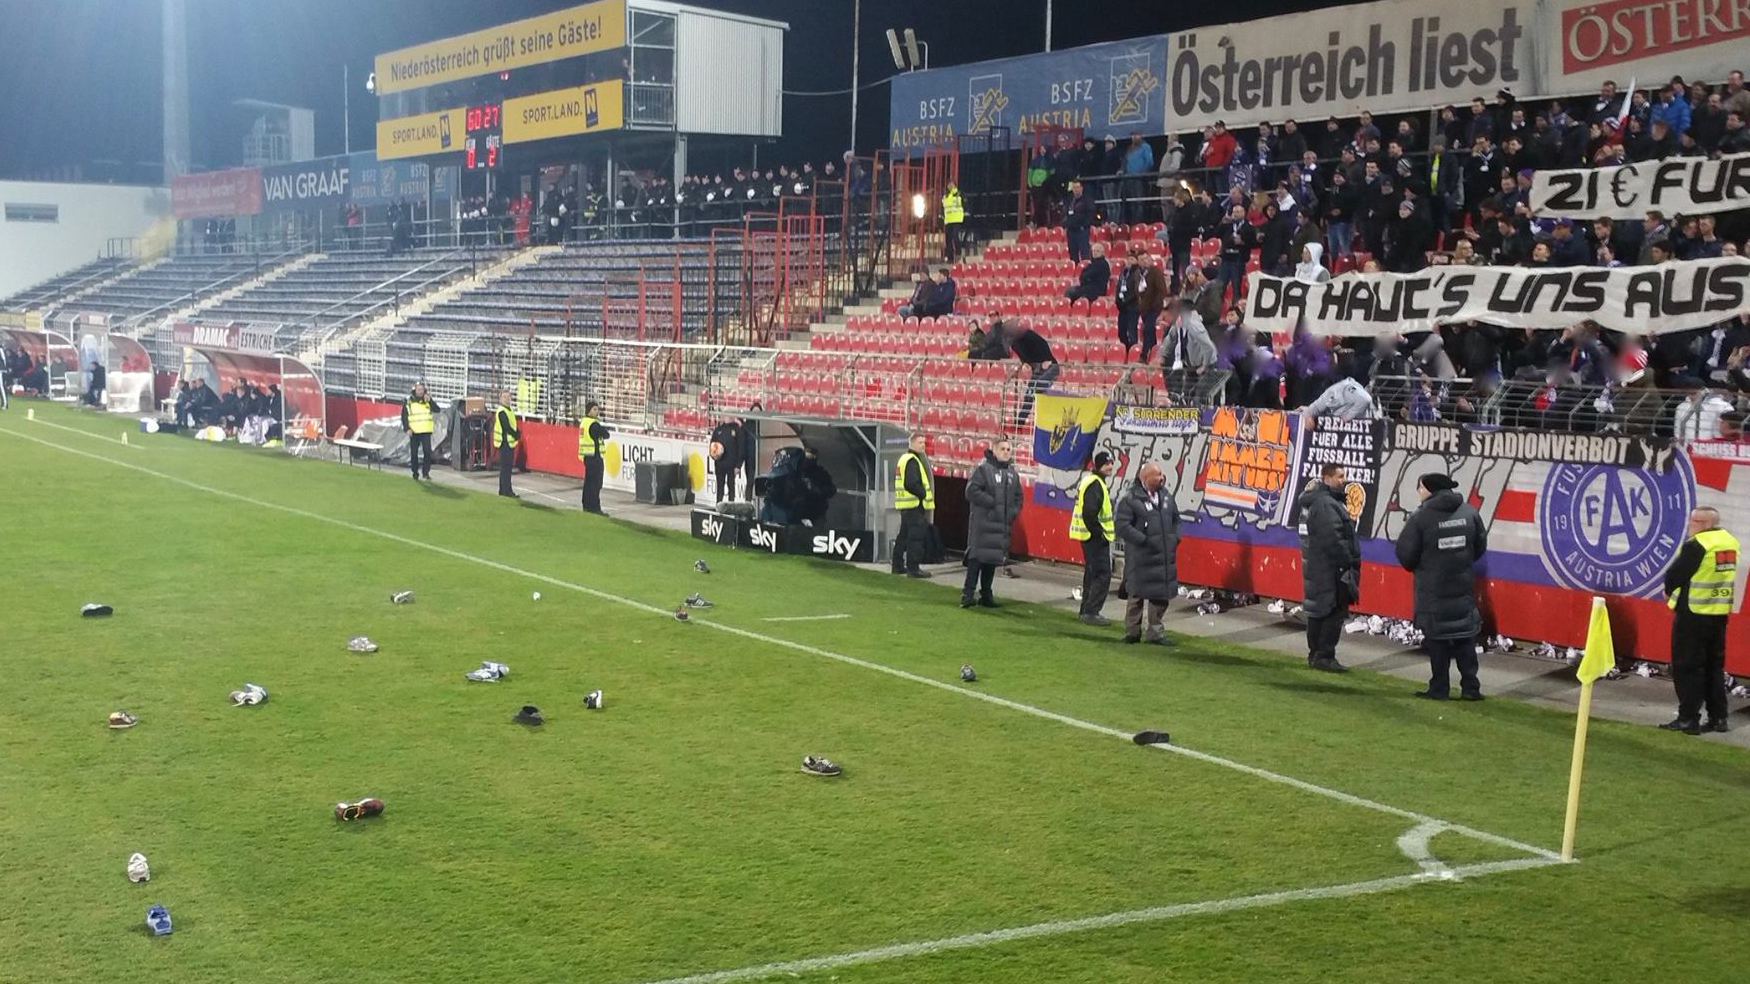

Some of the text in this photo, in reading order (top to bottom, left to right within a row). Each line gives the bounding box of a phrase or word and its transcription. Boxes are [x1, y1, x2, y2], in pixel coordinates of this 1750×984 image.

[391, 15, 602, 82] Niederösterreich grüßt seine Gäste!
[1172, 8, 1522, 116] Österreich liest
[1051, 79, 1093, 104] BSFZ
[523, 101, 583, 124] SPORT.LAND.
[920, 97, 955, 119] BSFZ
[1018, 108, 1091, 134] AUSTRIA
[392, 127, 438, 144] SPORT.LAND.
[892, 123, 953, 147] AUSTRIA
[264, 174, 293, 201] VAN
[296, 168, 349, 199] GRAAF
[1610, 165, 1639, 208] €
[1253, 279, 1311, 318] DA
[1487, 271, 1610, 313] UNS
[240, 332, 273, 351] ESTRICHE
[1133, 407, 1199, 421] SURRENDER
[1317, 416, 1373, 433] FREIHEIT
[1312, 431, 1374, 450] FUER ALLE
[1395, 424, 1631, 465] GRUPPE STADIONVERBOT
[622, 443, 655, 463] LICHT
[1307, 447, 1374, 467] FUSSBALL-
[702, 514, 724, 543] sky
[1553, 514, 1568, 531] 19
[749, 524, 777, 553] sky
[812, 530, 861, 561] sky
[1565, 533, 1676, 588] AUSTRIA WIEN
[1710, 588, 1730, 598] 39
